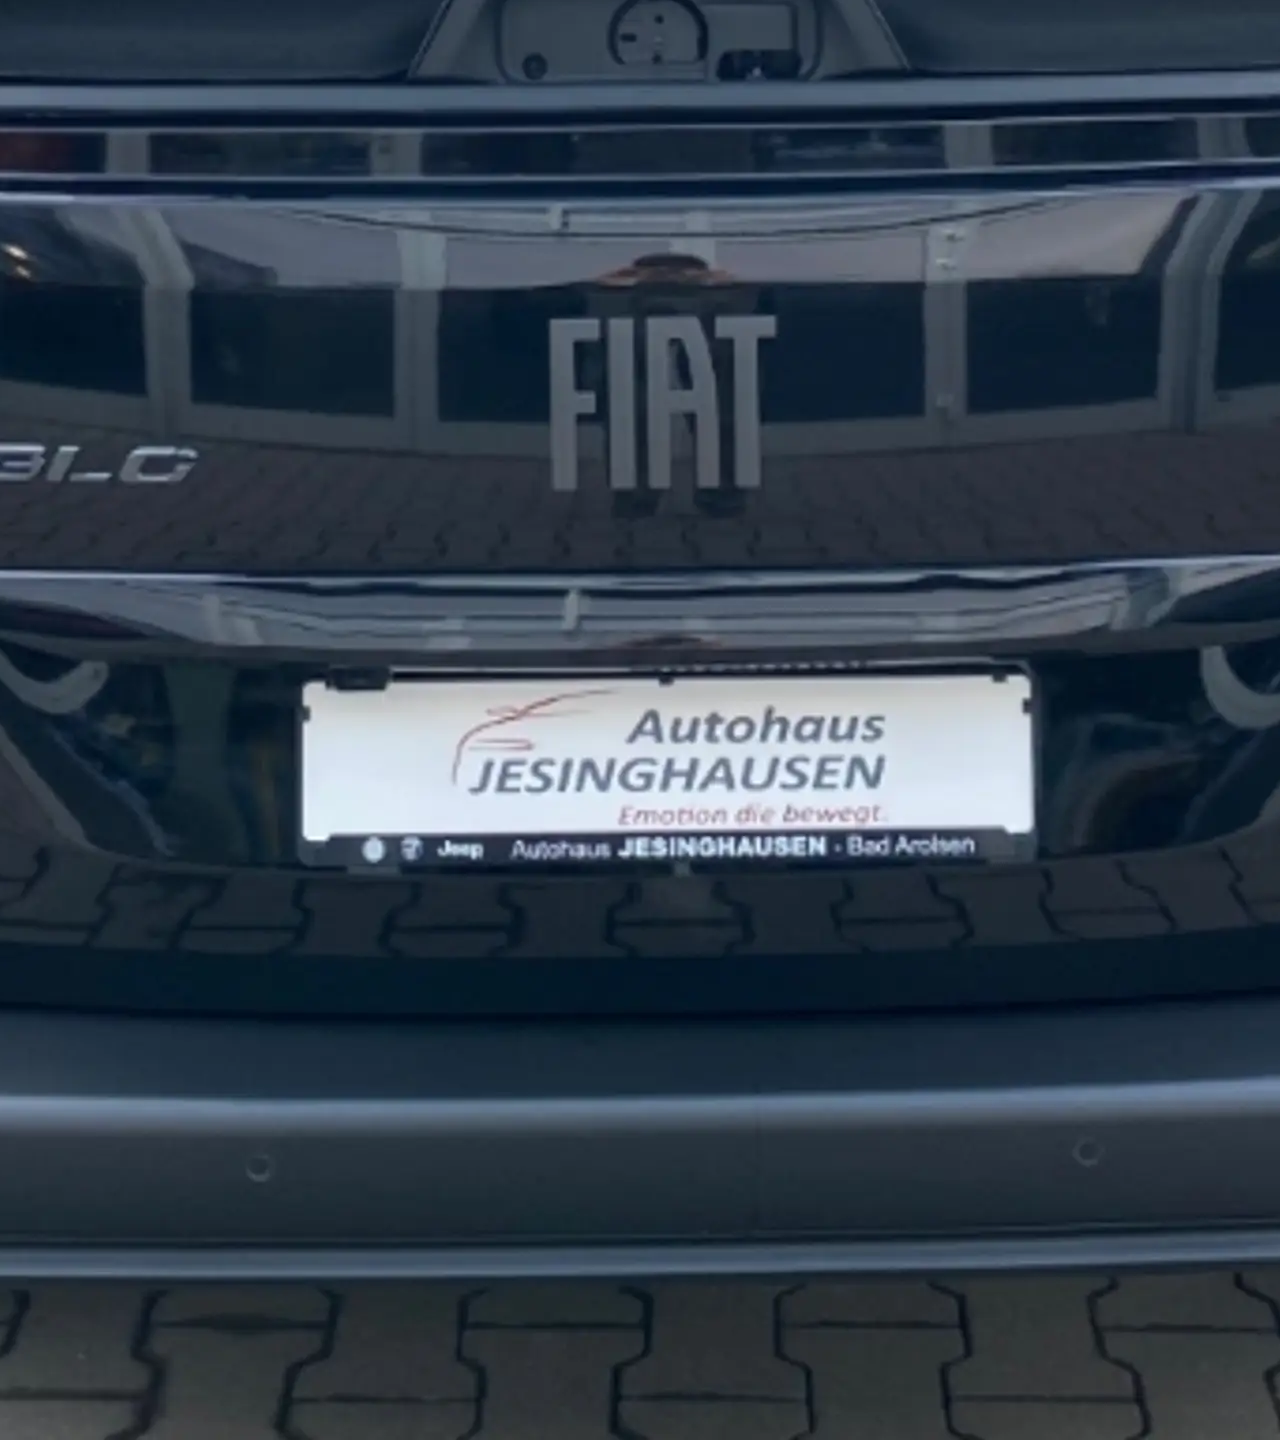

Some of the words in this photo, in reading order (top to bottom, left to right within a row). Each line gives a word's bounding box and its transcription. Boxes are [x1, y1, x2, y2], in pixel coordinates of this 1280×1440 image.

[549, 315, 777, 491] FIAT
[626, 705, 885, 744] Autohaus
[469, 754, 886, 794] JESINGHAUSEN
[618, 806, 727, 826] Emotion
[734, 803, 775, 825] die
[782, 803, 888, 827] bewegt.
[437, 840, 484, 859] Jeep
[510, 840, 610, 859] Autohaus
[618, 836, 827, 858] JESINGHAUSEN
[847, 836, 889, 856] Bad
[895, 834, 976, 854] Arolsen
